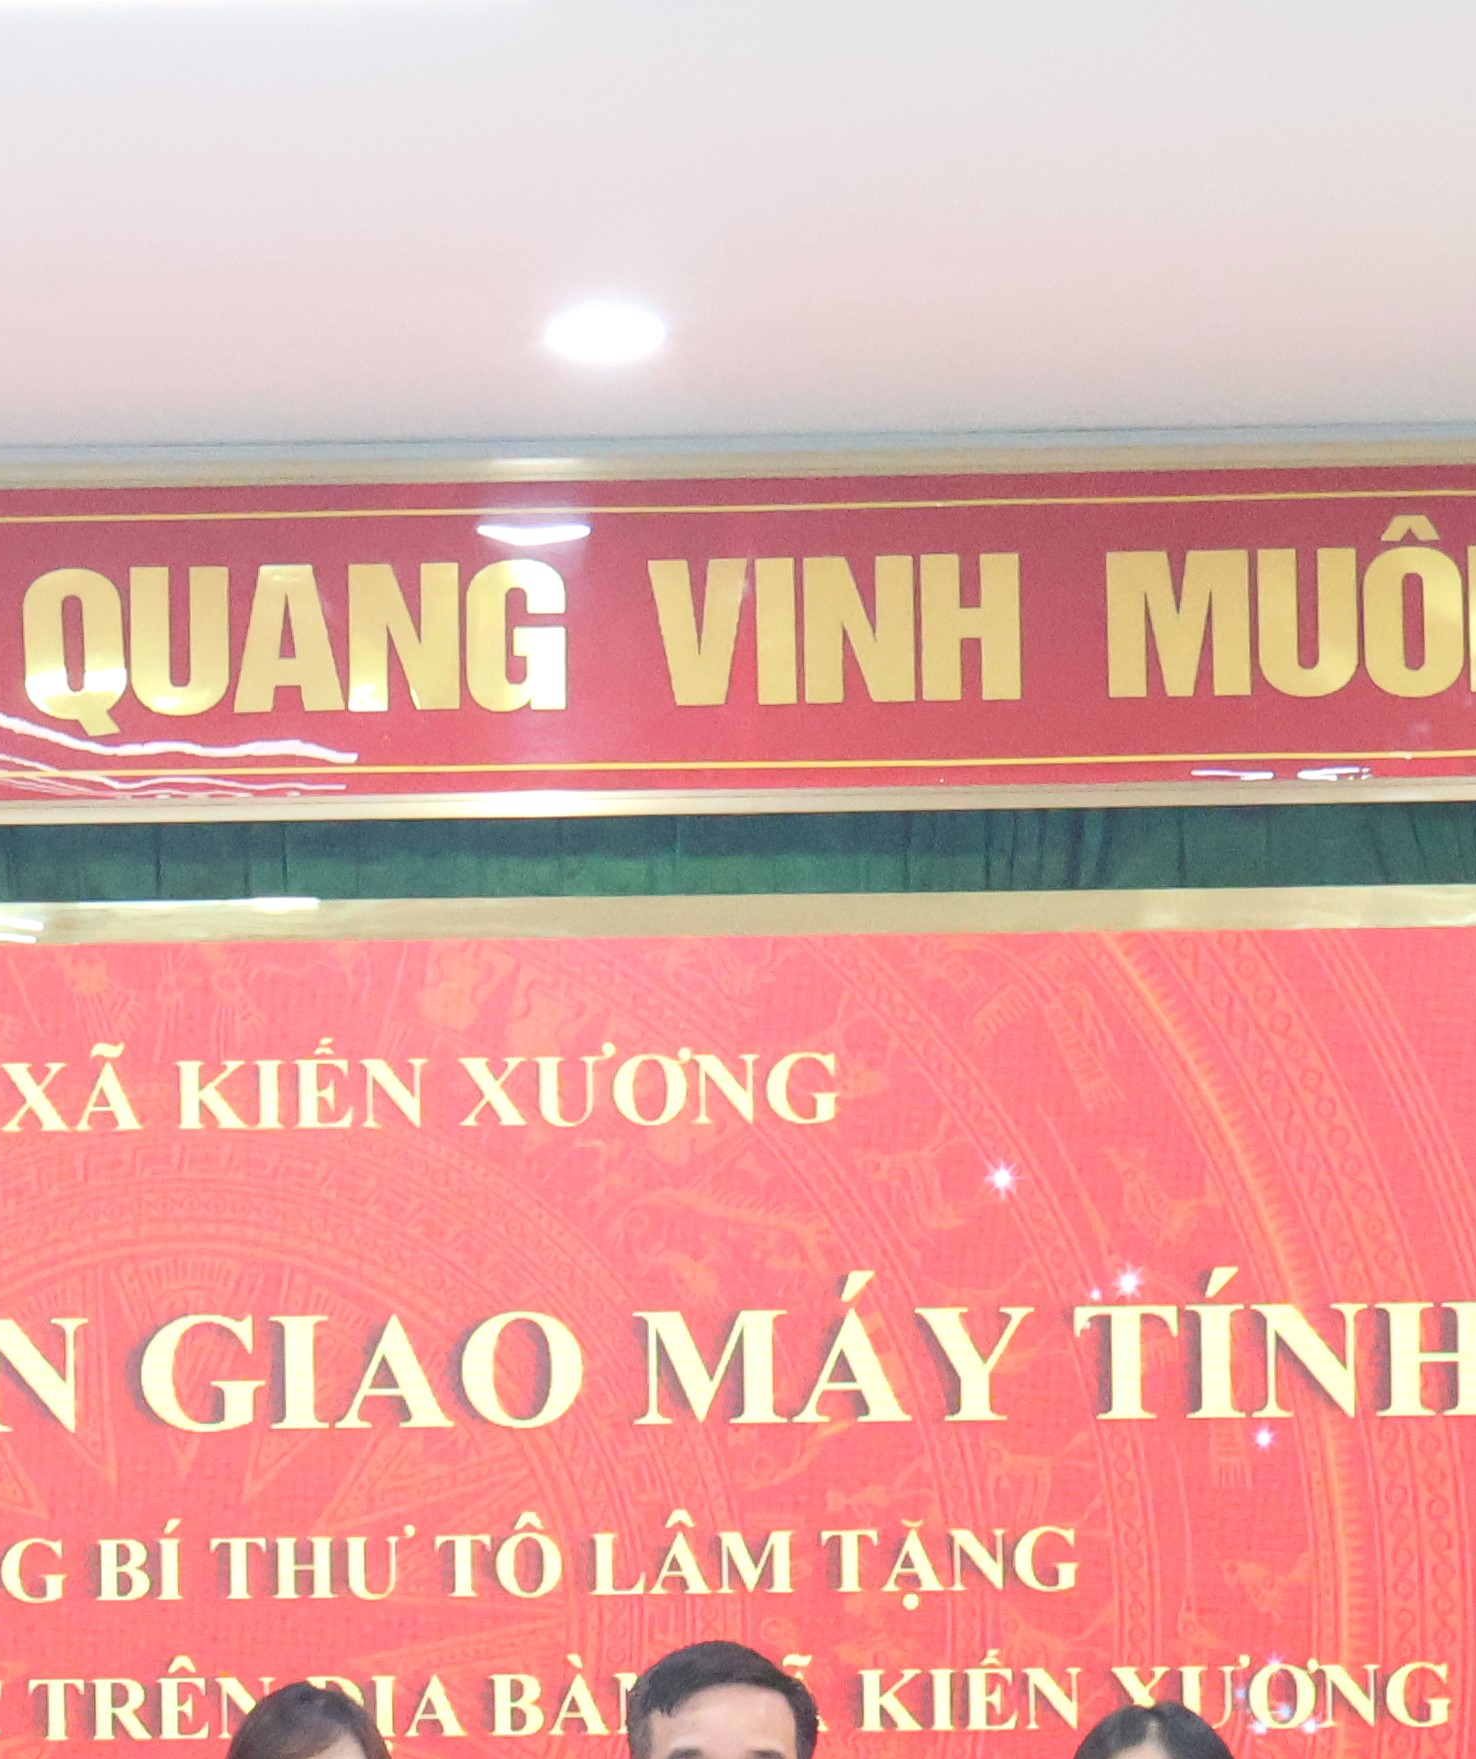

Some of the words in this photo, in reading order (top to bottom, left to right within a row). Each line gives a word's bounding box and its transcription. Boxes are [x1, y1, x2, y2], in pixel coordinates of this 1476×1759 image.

[23, 561, 567, 739] QUANG
[648, 552, 1023, 706] VINH
[2, 1043, 146, 1135] XÃ
[178, 1037, 430, 1132] KIẾN
[459, 1042, 841, 1130] XƯƠNG
[138, 1310, 587, 1432] GIAO
[636, 1270, 1035, 1427] MÁY
[98, 1518, 184, 1601] BÍ
[209, 1524, 419, 1601] THƯ
[435, 1510, 566, 1600] TÔ
[589, 1508, 796, 1597] LÂM
[821, 1519, 1081, 1611] TẶNG
[490, 1656, 639, 1737] BÀ
[859, 1649, 1078, 1733] KIẾN
[1110, 1654, 1452, 1730] XƯƠNG
